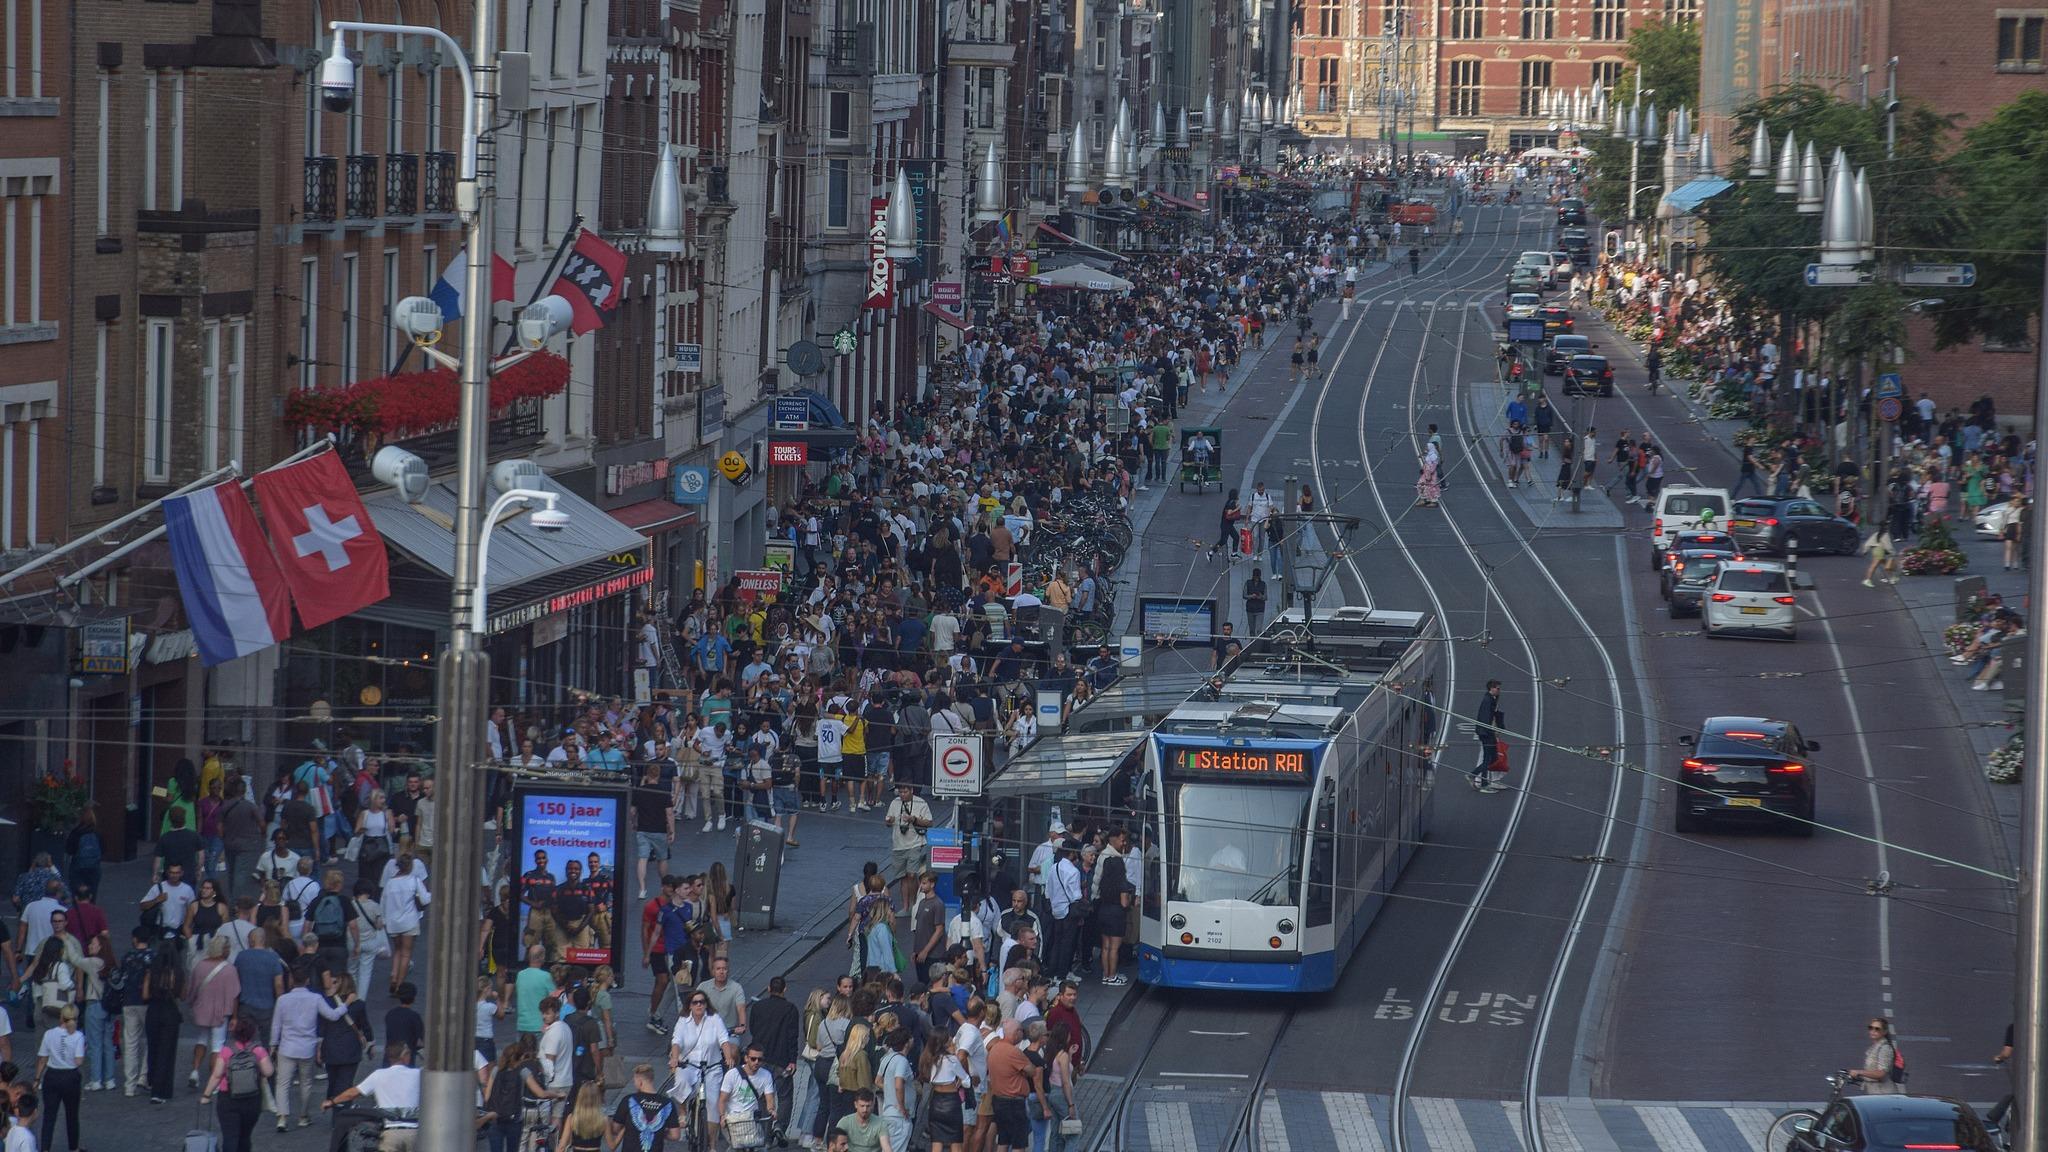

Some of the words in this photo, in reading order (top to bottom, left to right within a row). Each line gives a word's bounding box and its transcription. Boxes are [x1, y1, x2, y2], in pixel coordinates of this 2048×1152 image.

[774, 446, 797, 454] TOURS
[88, 659, 122, 672] ATM
[821, 729, 834, 744] 30
[1177, 750, 1186, 768] 4
[1200, 751, 1268, 771] Station
[1275, 753, 1303, 772] RAI
[537, 802, 566, 815] 150
[569, 803, 603, 820] jaar
[530, 836, 612, 849] Gefeliciteerd!
[1374, 1004, 1526, 1026] BUS
